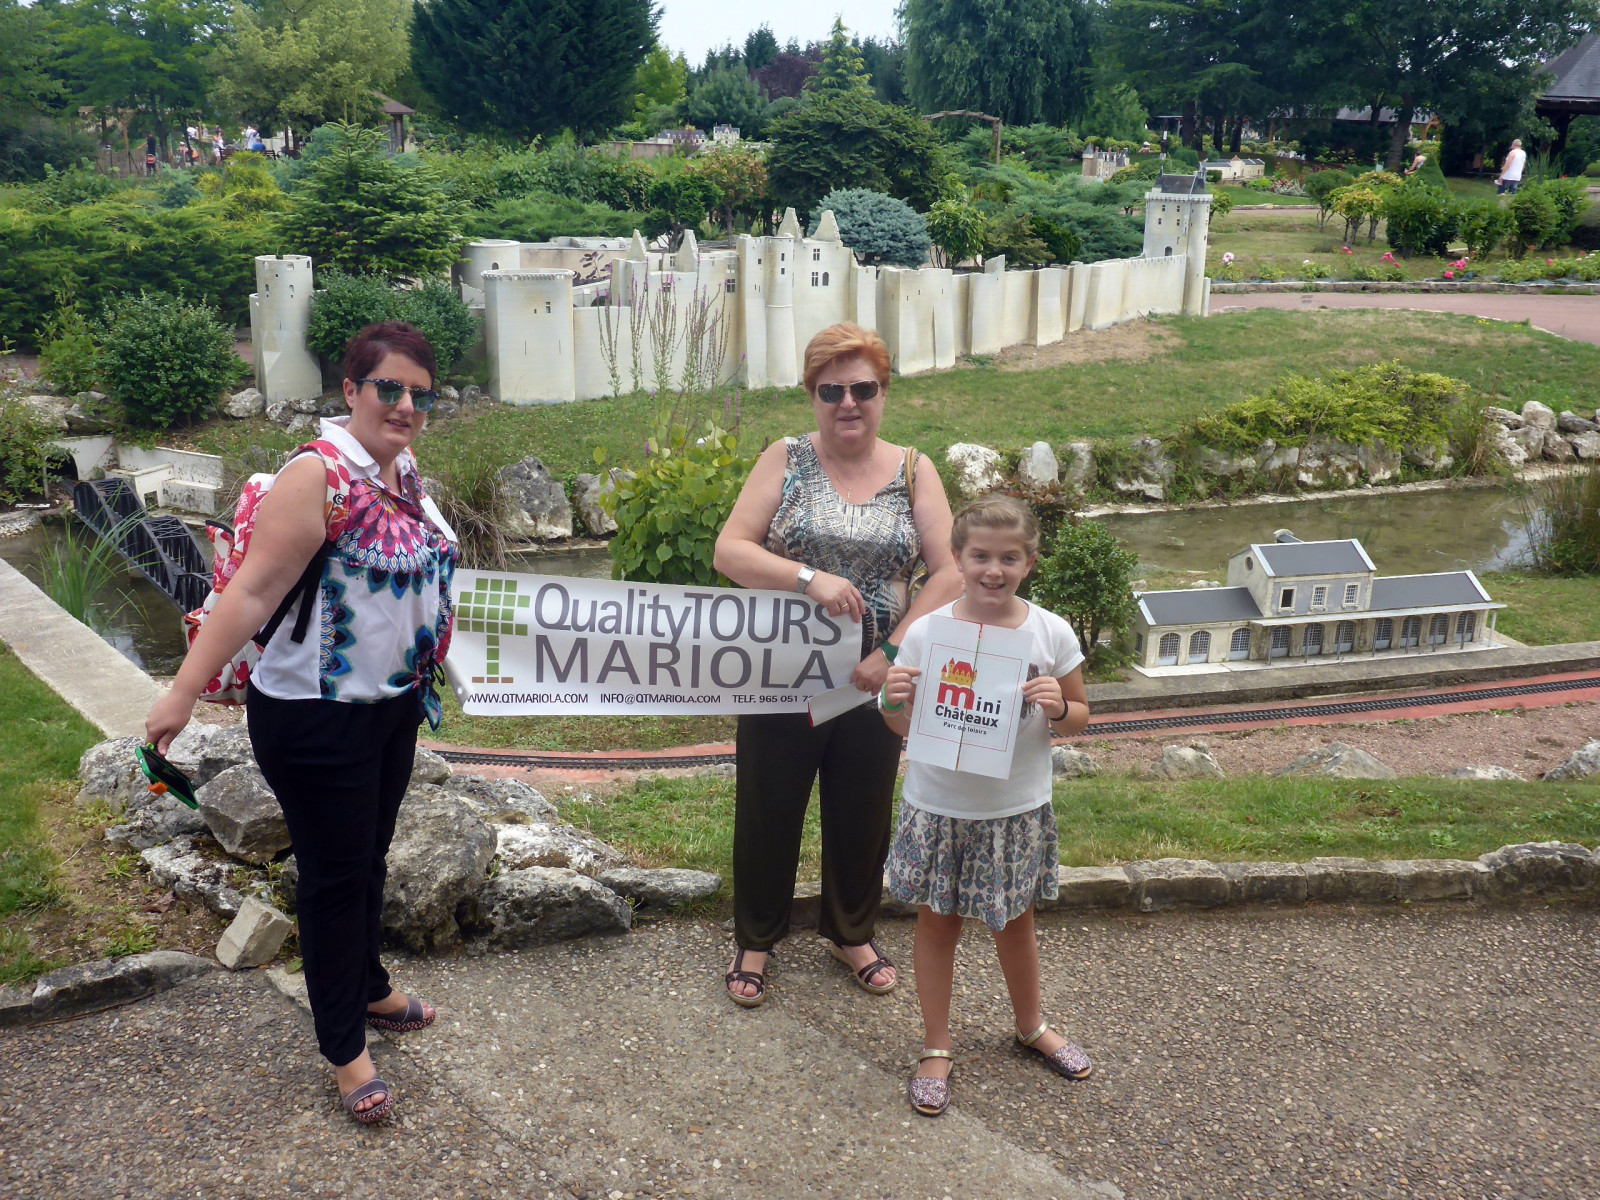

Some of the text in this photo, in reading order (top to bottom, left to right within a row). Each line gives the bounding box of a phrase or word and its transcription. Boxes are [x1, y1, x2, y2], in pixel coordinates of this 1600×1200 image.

[535, 634, 834, 689] MARIOLA
[467, 693, 589, 704] WWW.QTMARIOLA.COM
[600, 693, 721, 705] INFO@QTMARIOLA.COM
[732, 694, 756, 703] TELF.
[759, 695, 778, 703] 965
[780, 695, 798, 703] 051
[936, 682, 1002, 715] mini
[935, 704, 999, 728] Châteaux
[943, 721, 957, 730] Parc
[967, 726, 987, 735] loisirs
